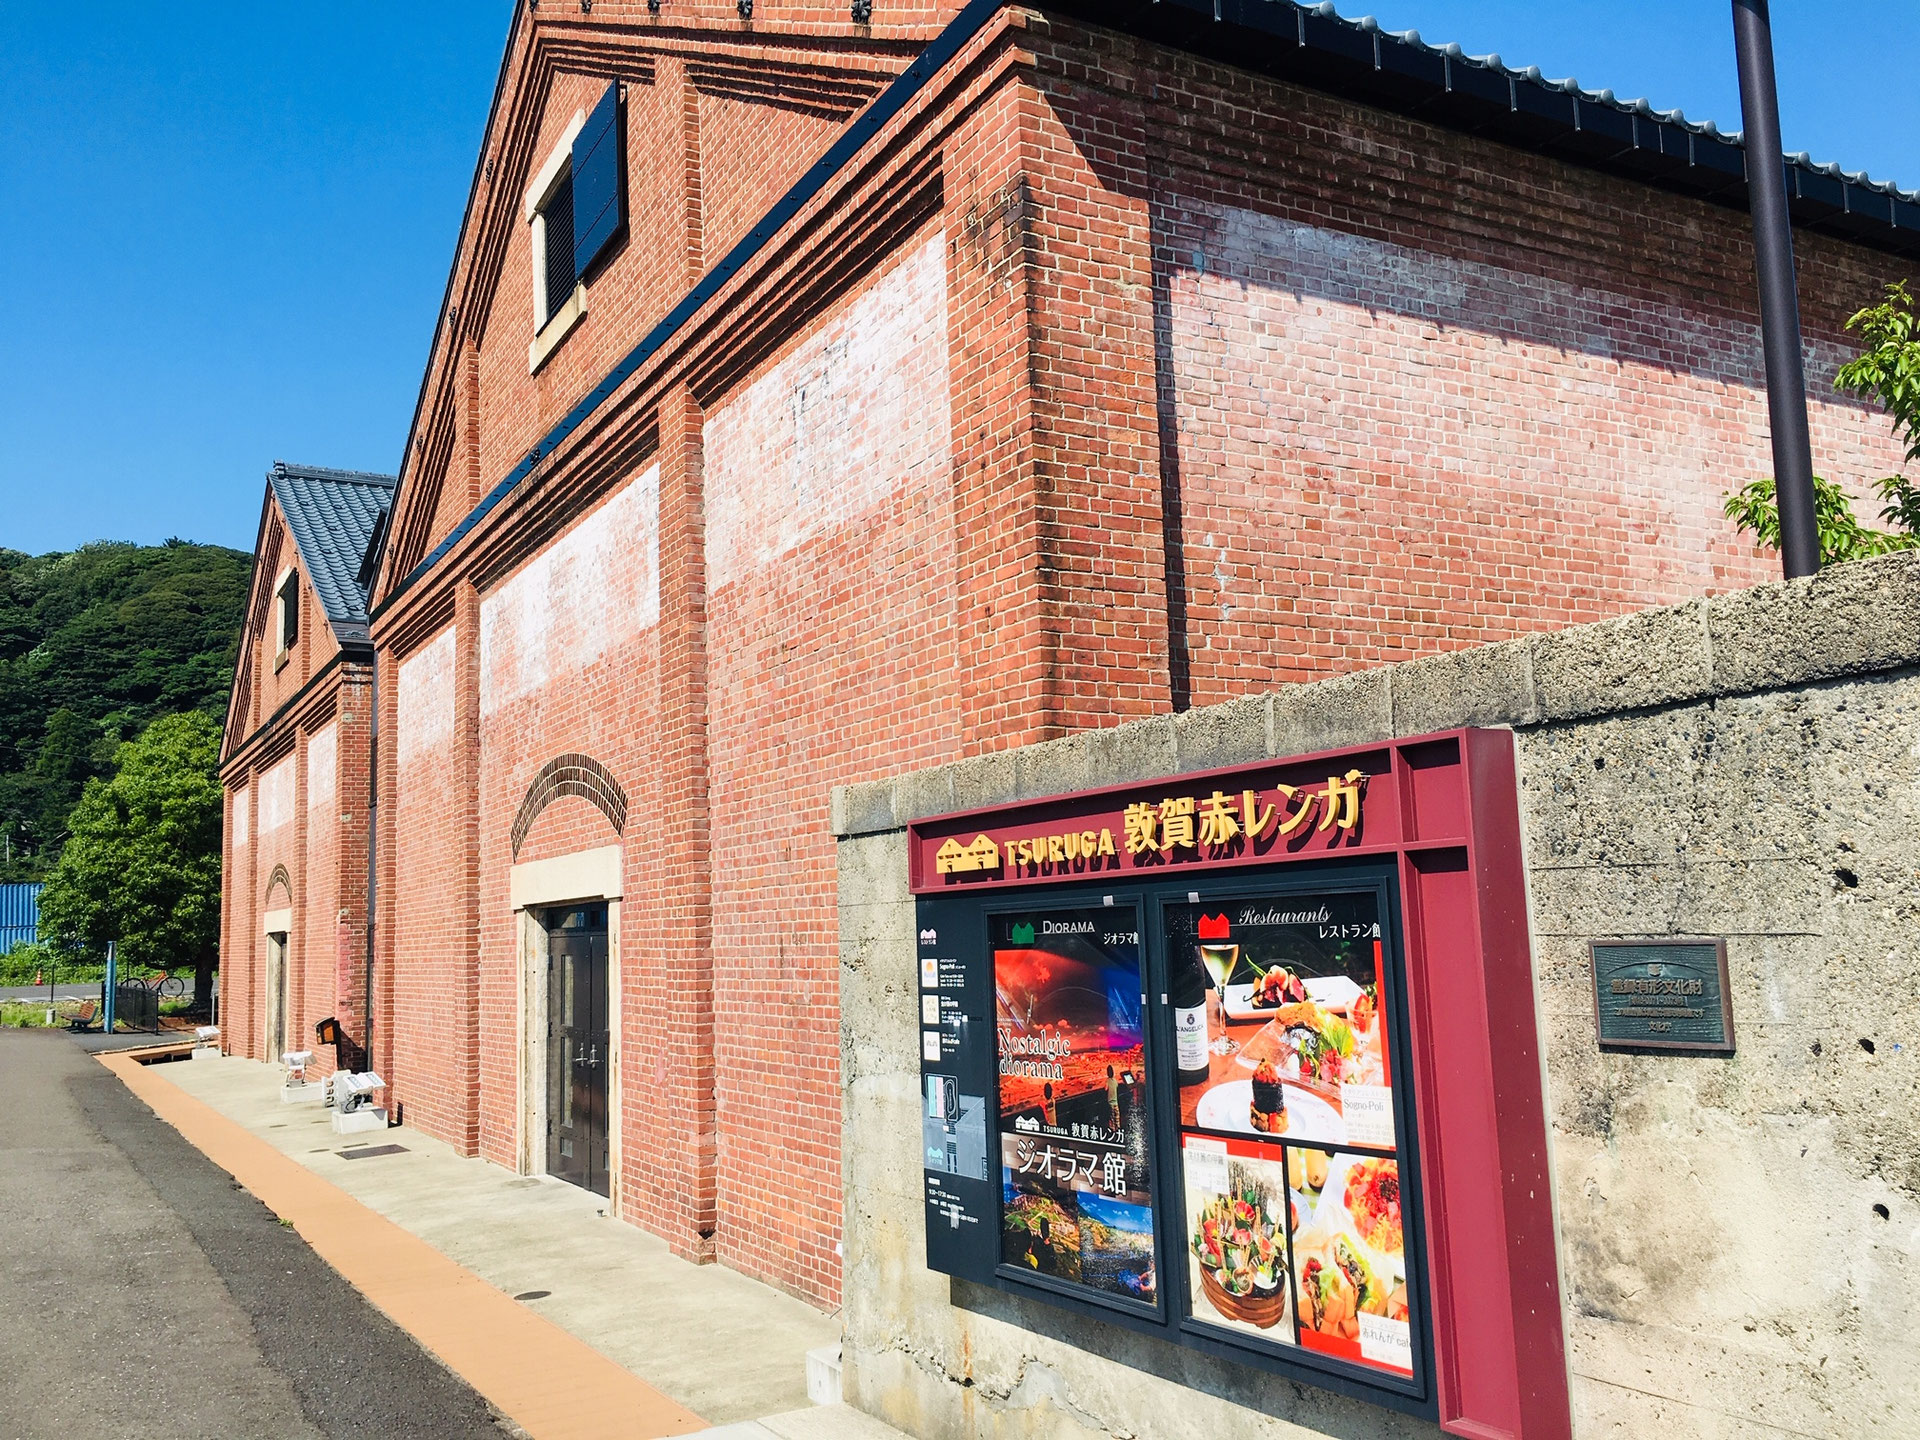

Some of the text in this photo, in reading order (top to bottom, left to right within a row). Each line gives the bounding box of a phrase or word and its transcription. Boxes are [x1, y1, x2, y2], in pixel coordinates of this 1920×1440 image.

[1004, 768, 1363, 867] TSURUGA 敦賀赤レンガ
[1239, 903, 1332, 926] Restaurants
[1611, 978, 1703, 996] 登録有形文化財
[997, 1028, 1071, 1061] Nostalgic
[999, 1051, 1064, 1080] diorama
[1043, 1121, 1126, 1144] TSURUGA 敦賀赤レンガ
[1016, 1138, 1128, 1196] ジオラマ館
